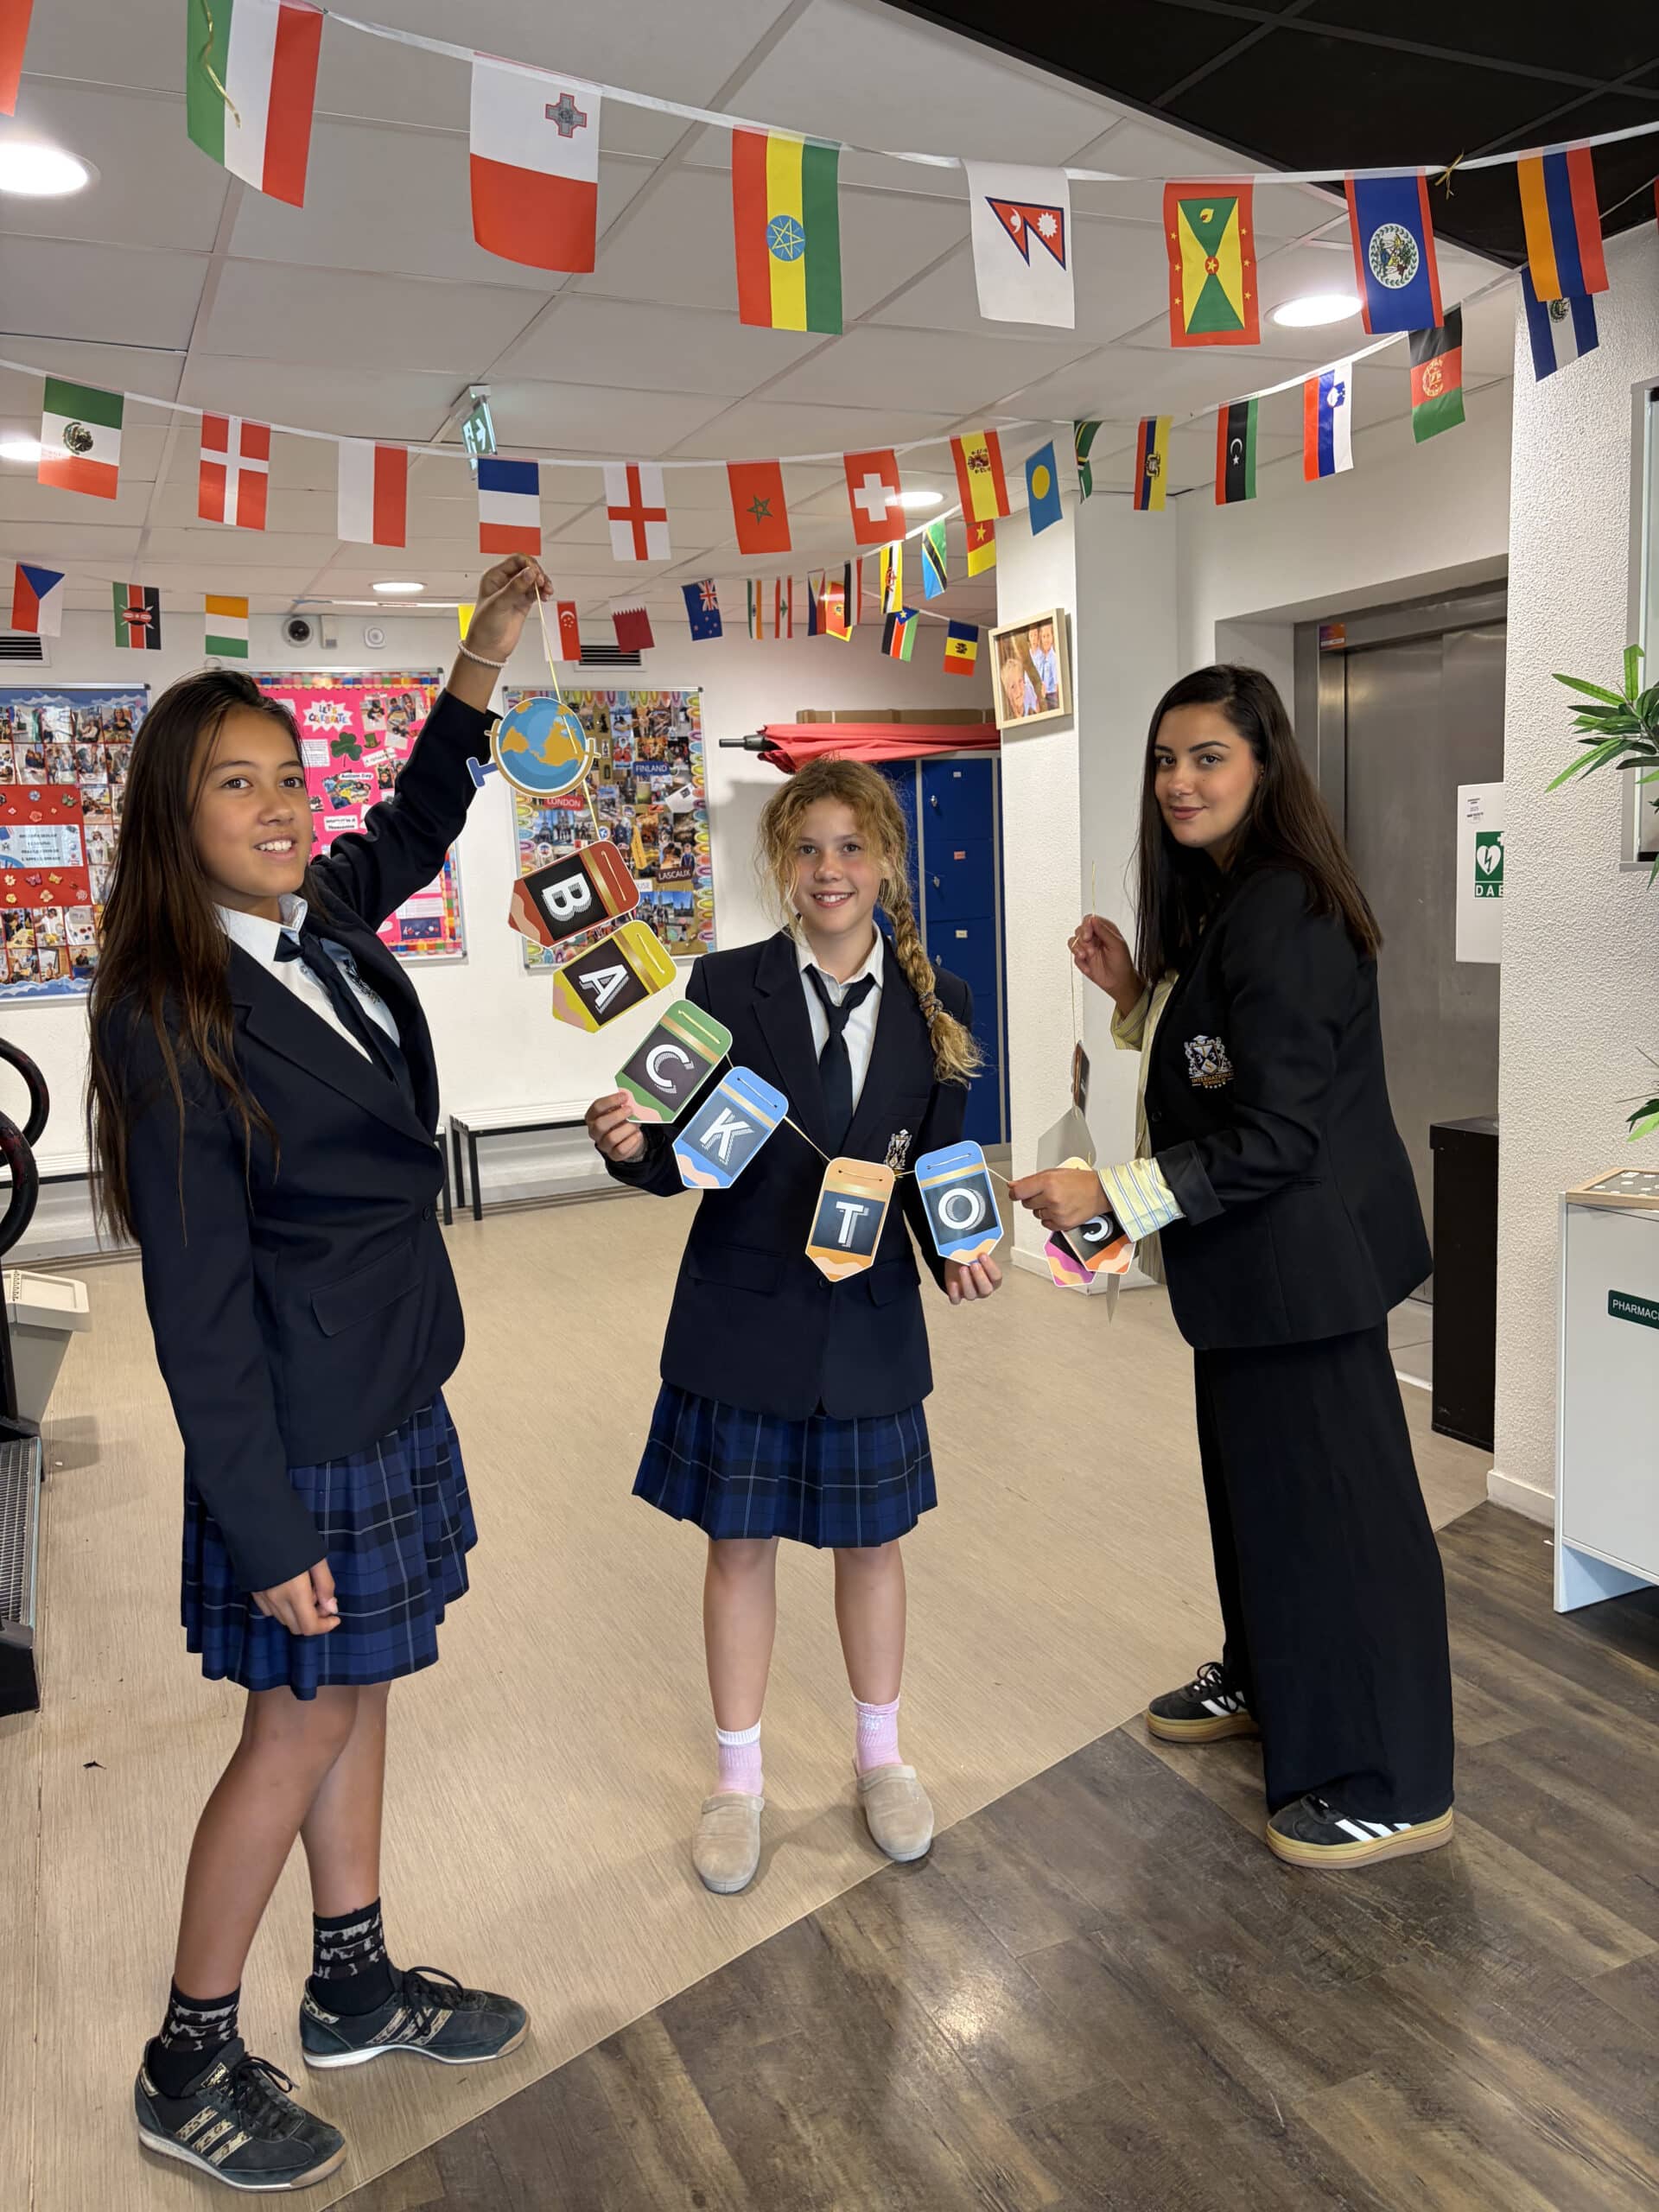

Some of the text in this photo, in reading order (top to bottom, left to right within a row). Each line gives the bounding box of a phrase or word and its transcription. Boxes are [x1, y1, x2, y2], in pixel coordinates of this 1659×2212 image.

[635, 764, 668, 772] FINLAND
[547, 797, 582, 808] LONDON
[658, 869, 691, 880] LASCAUX
